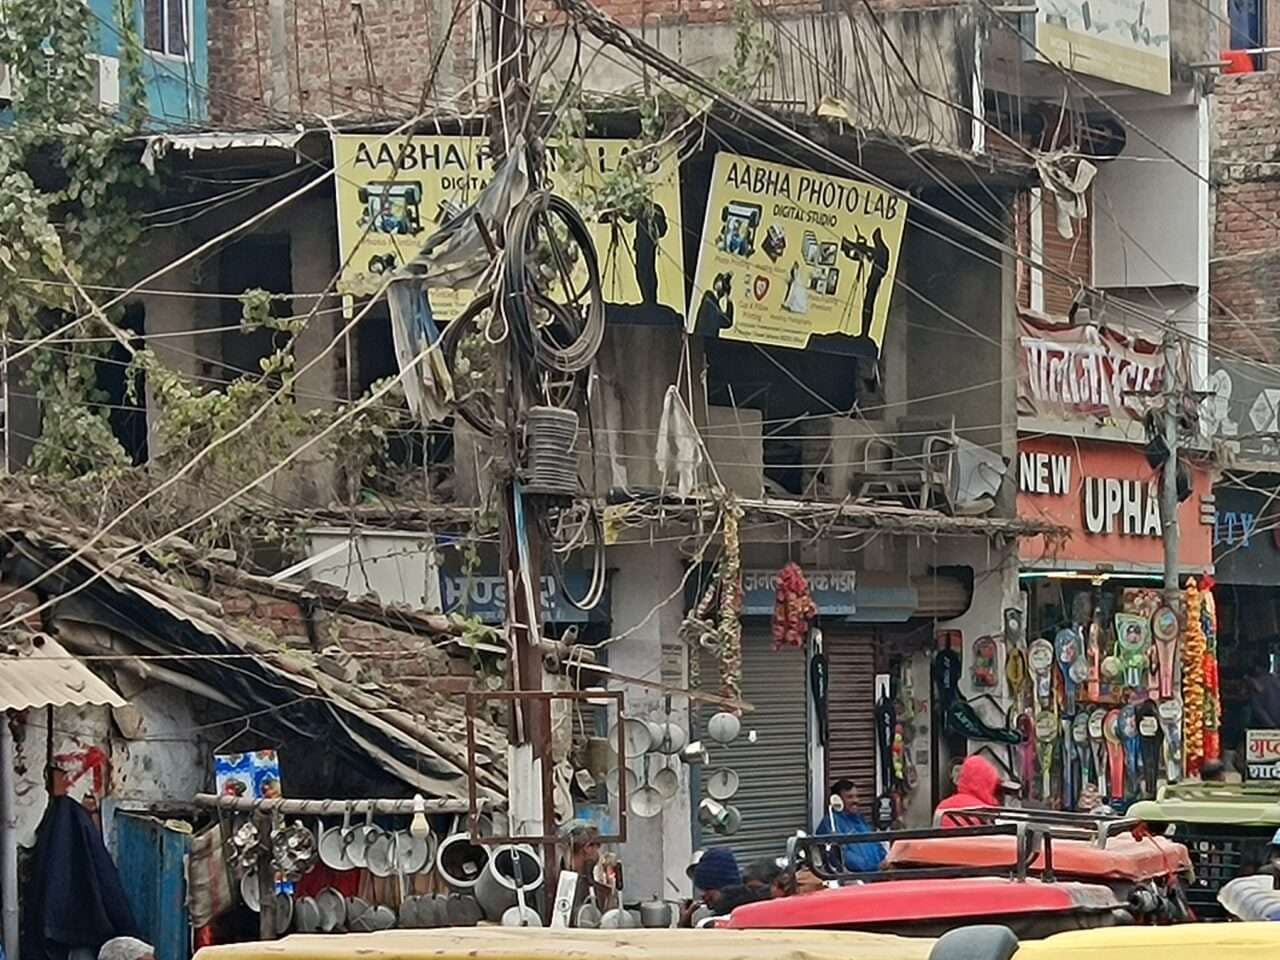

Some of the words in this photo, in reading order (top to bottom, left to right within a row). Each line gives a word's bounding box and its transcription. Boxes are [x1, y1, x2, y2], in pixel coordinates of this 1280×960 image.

[353, 143, 466, 170] AABHA
[442, 176, 490, 191] DIGITA
[725, 161, 791, 198] AABHA
[797, 176, 859, 213] PHOTO
[863, 190, 899, 220] LAB
[773, 204, 804, 221] DIGITAL
[806, 210, 838, 227] STUDIO
[1019, 451, 1072, 495] NEW
[1085, 476, 1170, 537] UPHA
[1214, 511, 1254, 548] ITY
